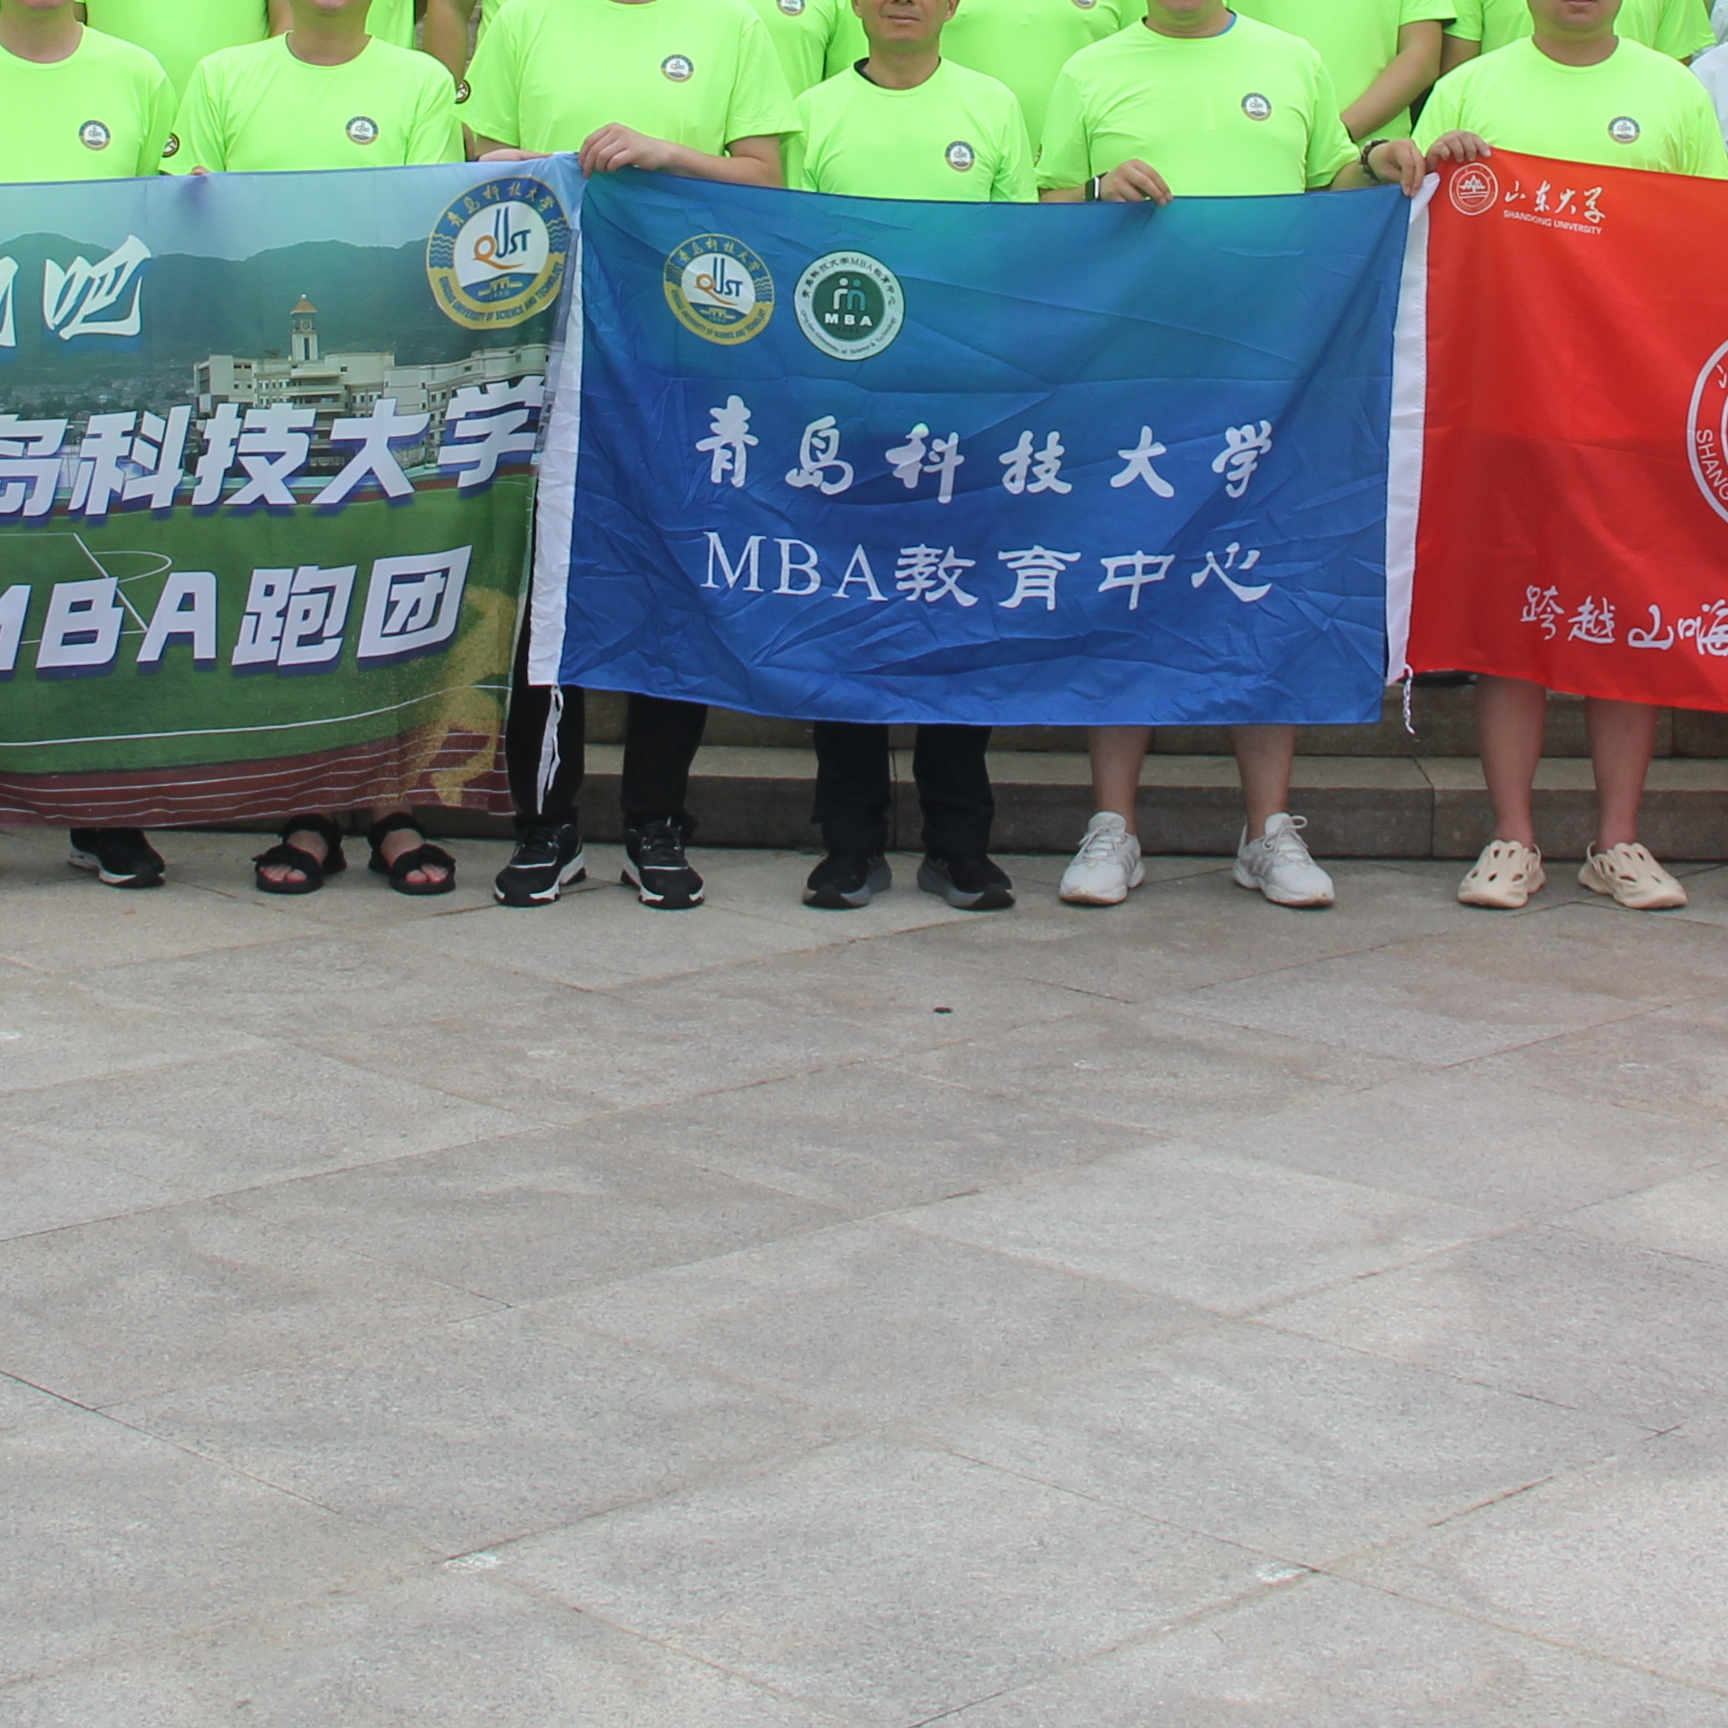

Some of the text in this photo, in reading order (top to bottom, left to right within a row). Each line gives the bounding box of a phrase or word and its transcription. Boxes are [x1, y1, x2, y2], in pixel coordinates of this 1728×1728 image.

[1503, 209, 1602, 235] SHANDONG UNIVERSITY
[1504, 180, 1606, 223] 山东大学
[825, 312, 872, 326] MBA
[696, 394, 1273, 504] 青岛科技大学
[702, 530, 1273, 611] MBA教育中心
